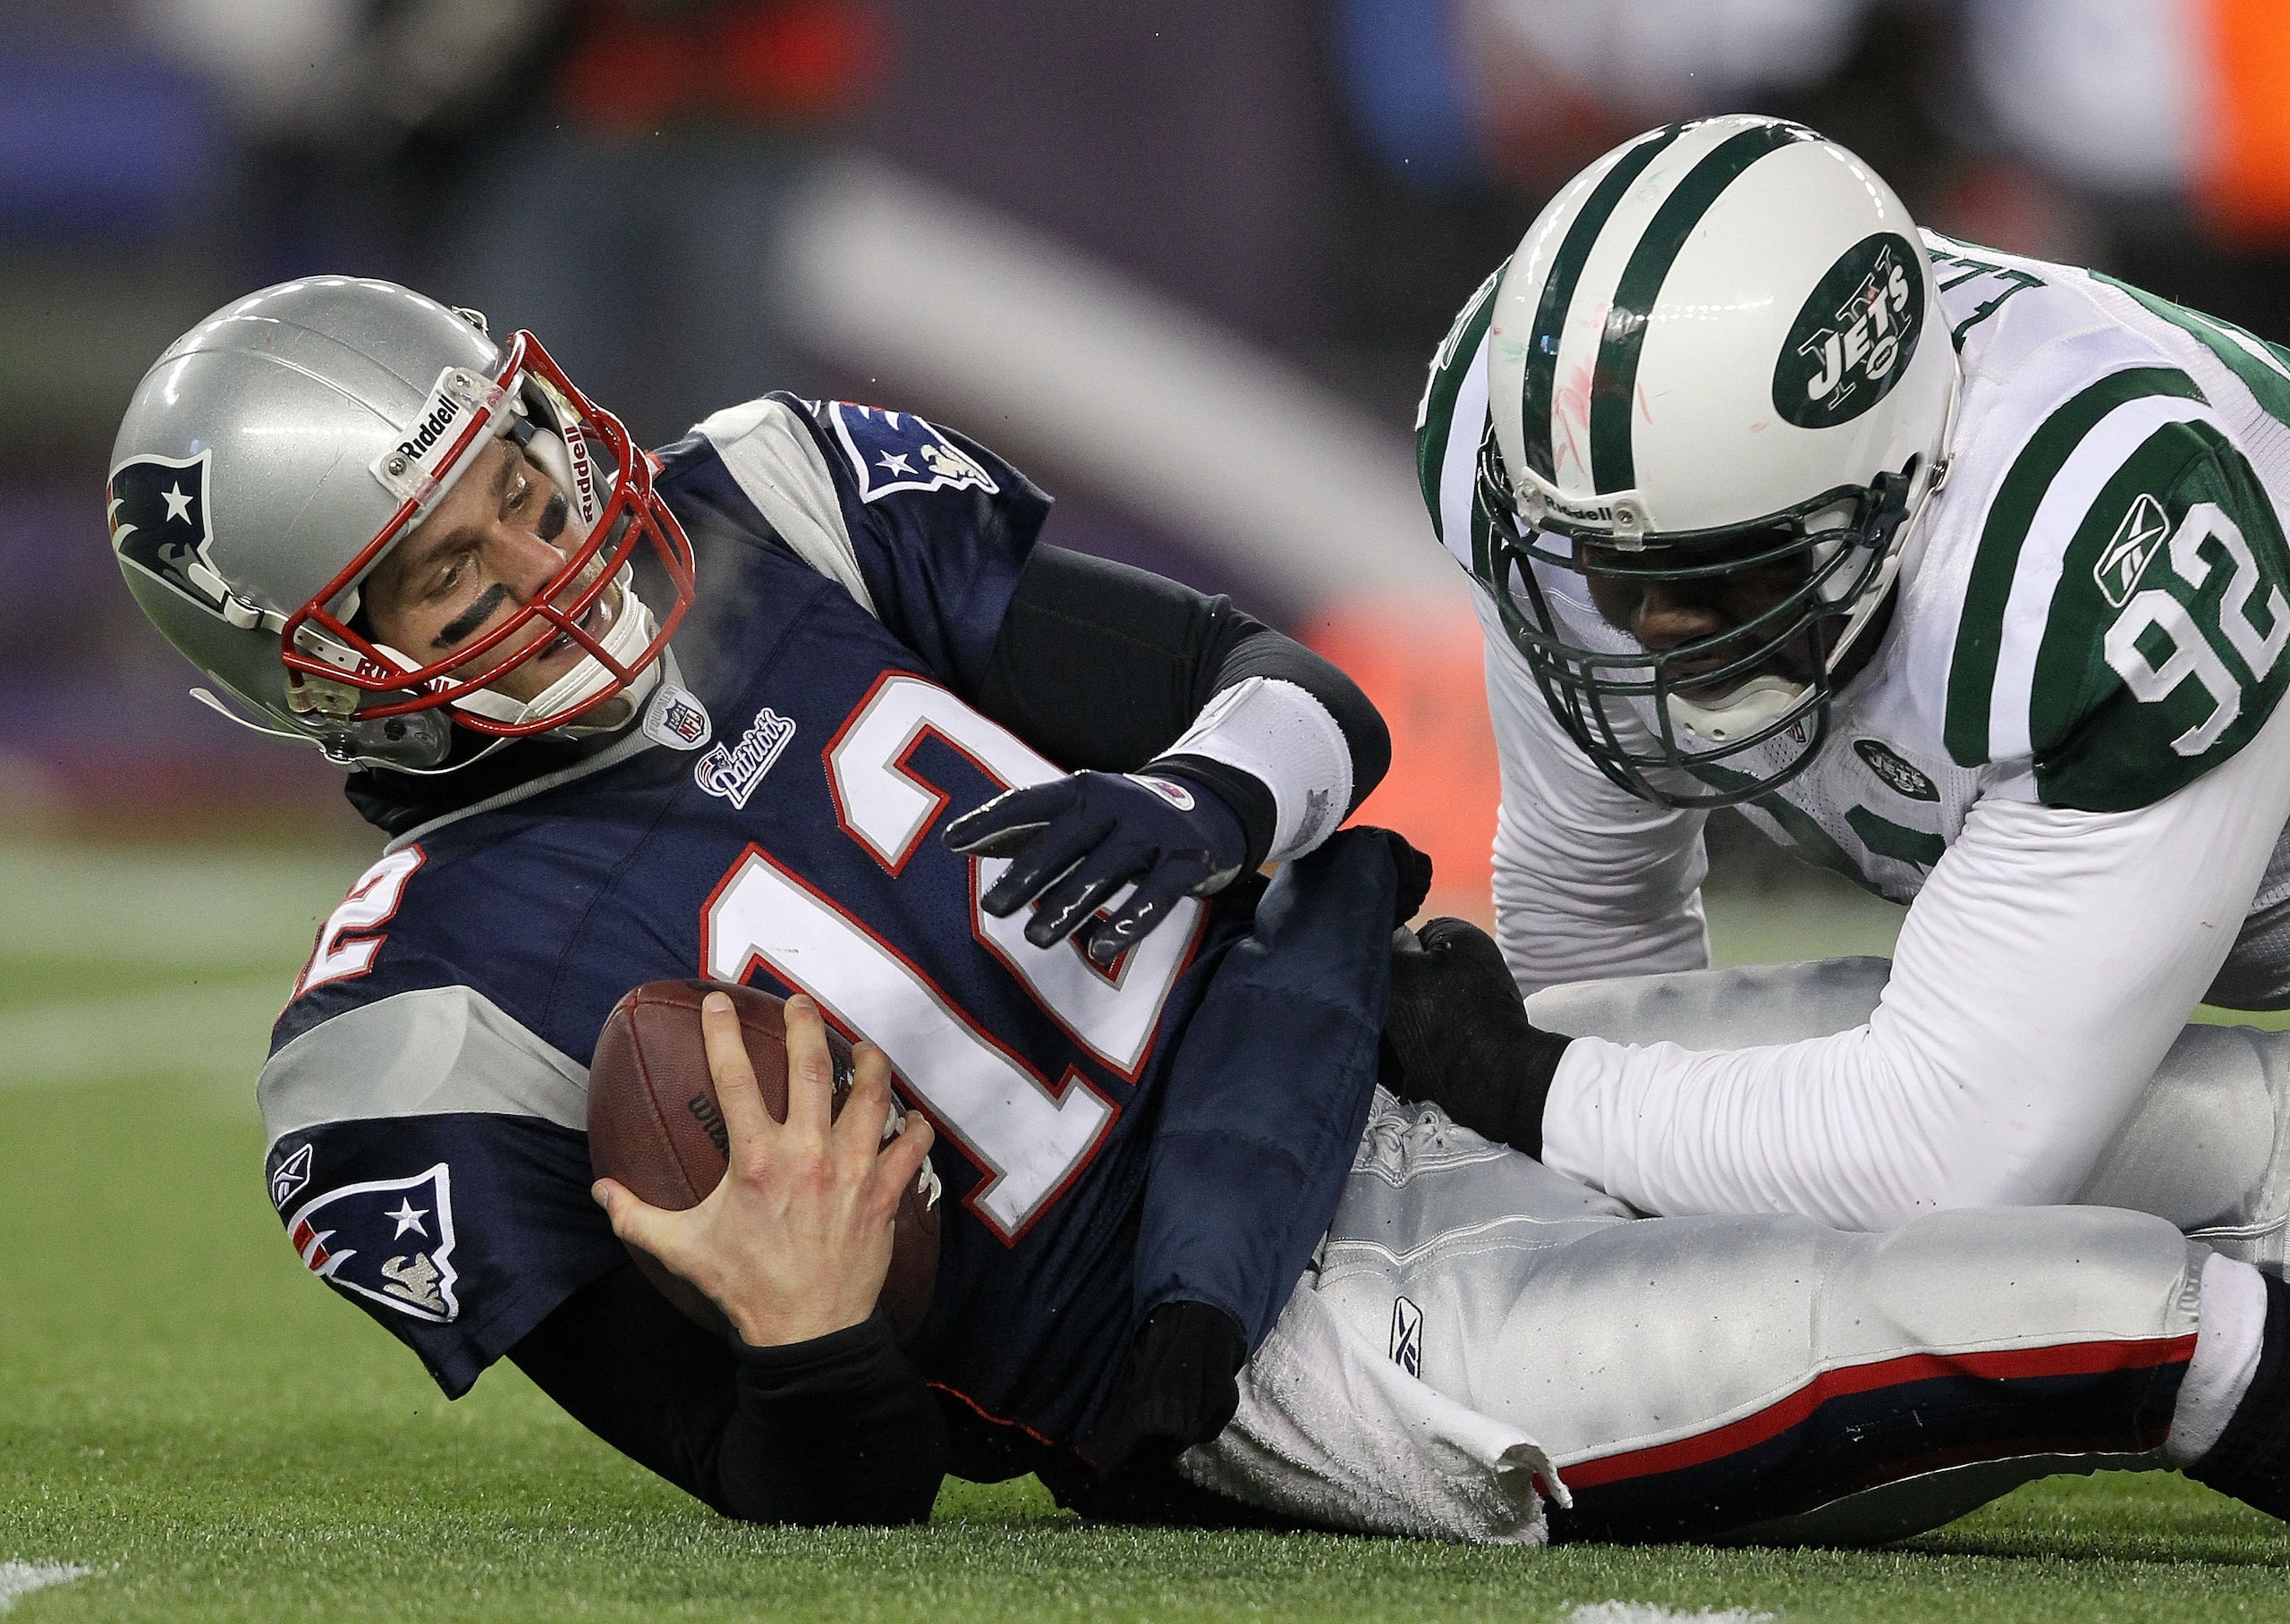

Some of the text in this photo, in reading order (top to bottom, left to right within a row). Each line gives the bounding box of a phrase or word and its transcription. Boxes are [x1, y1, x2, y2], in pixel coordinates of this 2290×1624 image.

[1808, 265, 1909, 401] JETS
[396, 393, 460, 464] Riddell
[564, 426, 593, 523] Riddell
[2105, 503, 2290, 757] 92
[648, 686, 680, 735] EQUIPMENT
[678, 712, 702, 741] NFL
[710, 709, 791, 803] Patriots
[699, 670, 1210, 1248] 12
